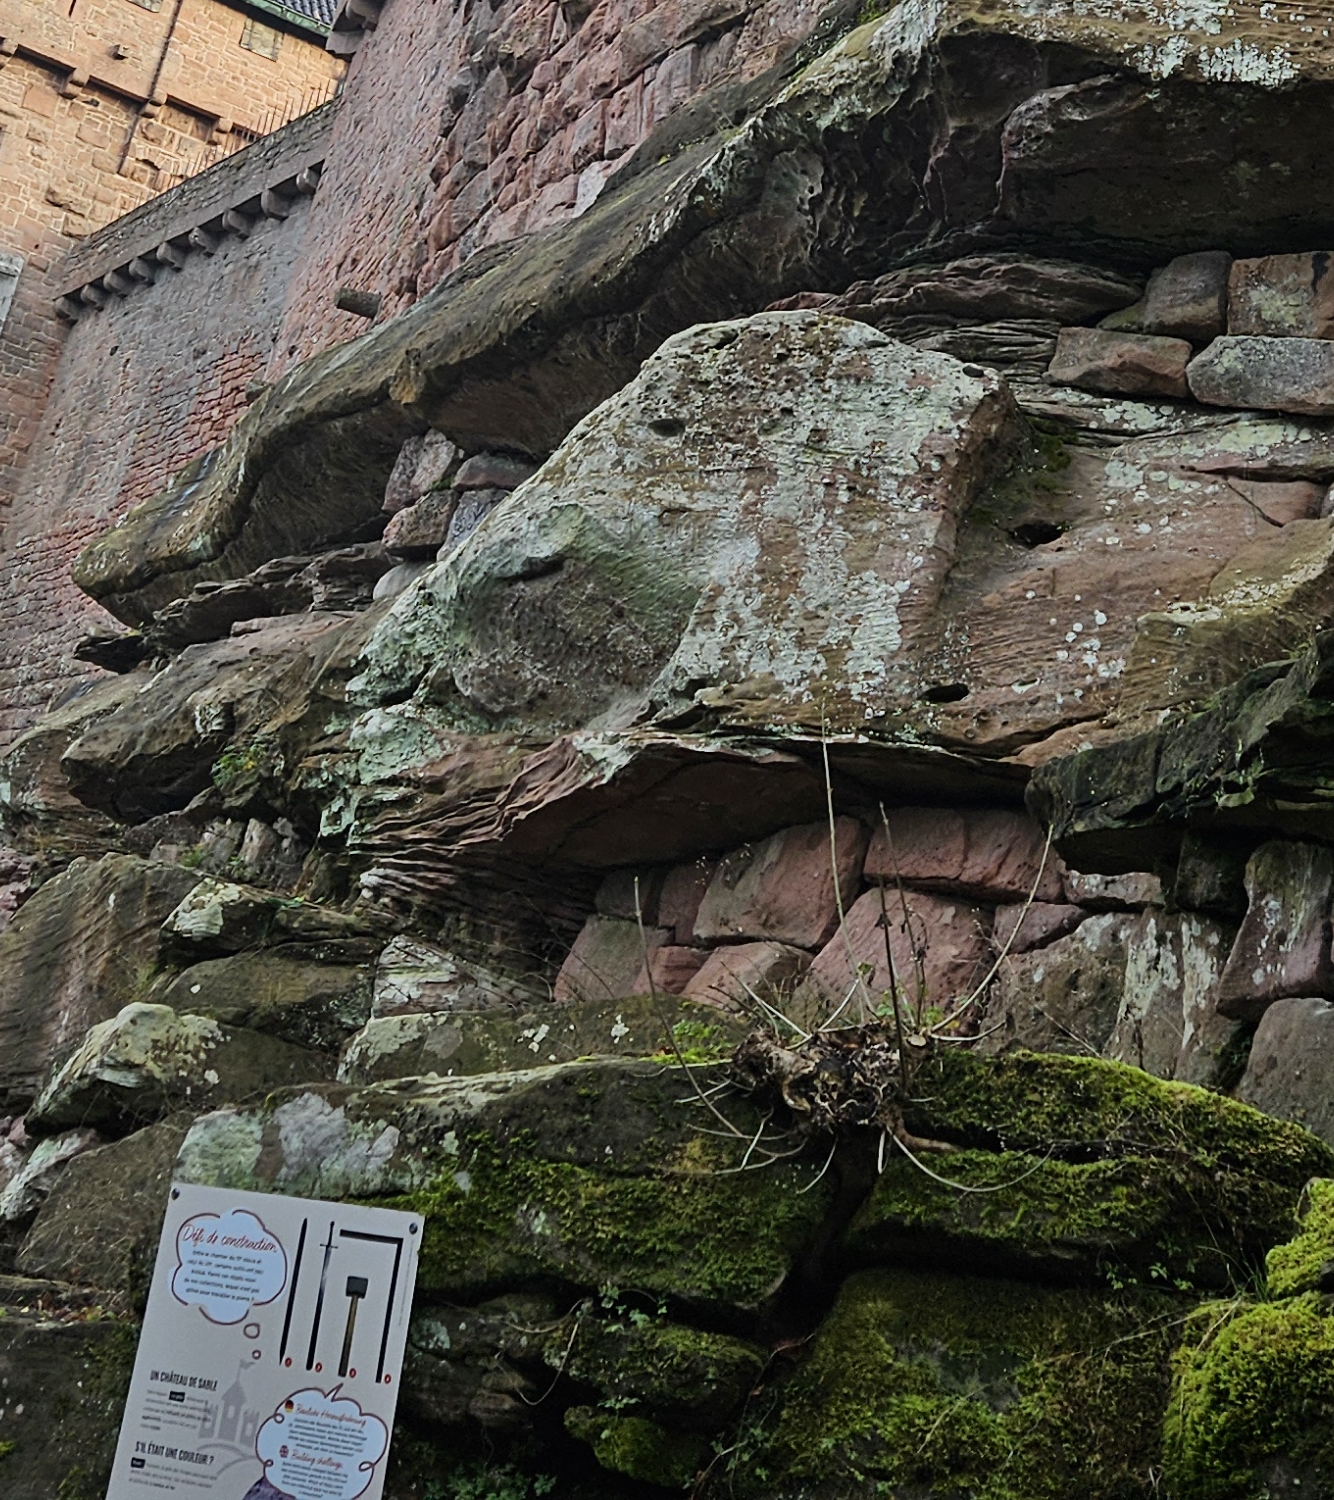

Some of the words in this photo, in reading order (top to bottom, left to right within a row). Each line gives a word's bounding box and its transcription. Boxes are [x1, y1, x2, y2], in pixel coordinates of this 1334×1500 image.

[207, 1230, 218, 1244] de
[222, 1236, 278, 1253] construction
[188, 1377, 198, 1388] DE
[147, 1441, 165, 1456] ÉTAIT
[165, 1447, 178, 1460] UNE
[179, 1449, 208, 1465] COULEUR
